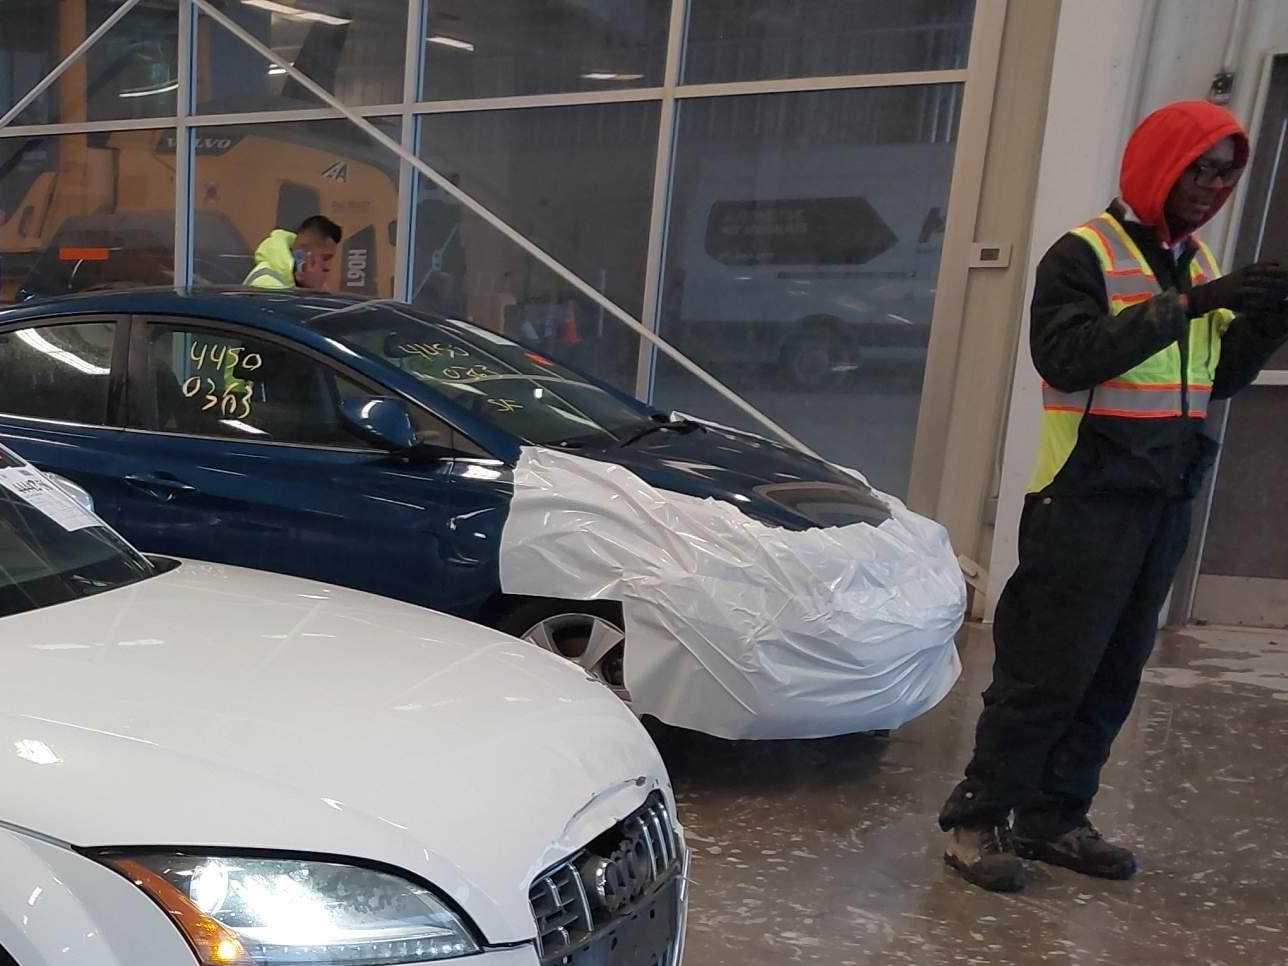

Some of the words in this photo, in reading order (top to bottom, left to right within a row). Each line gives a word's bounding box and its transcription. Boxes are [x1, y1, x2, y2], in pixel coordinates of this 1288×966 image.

[167, 138, 232, 149] VLVO
[347, 249, 368, 287] L90H
[190, 341, 262, 370] 4450
